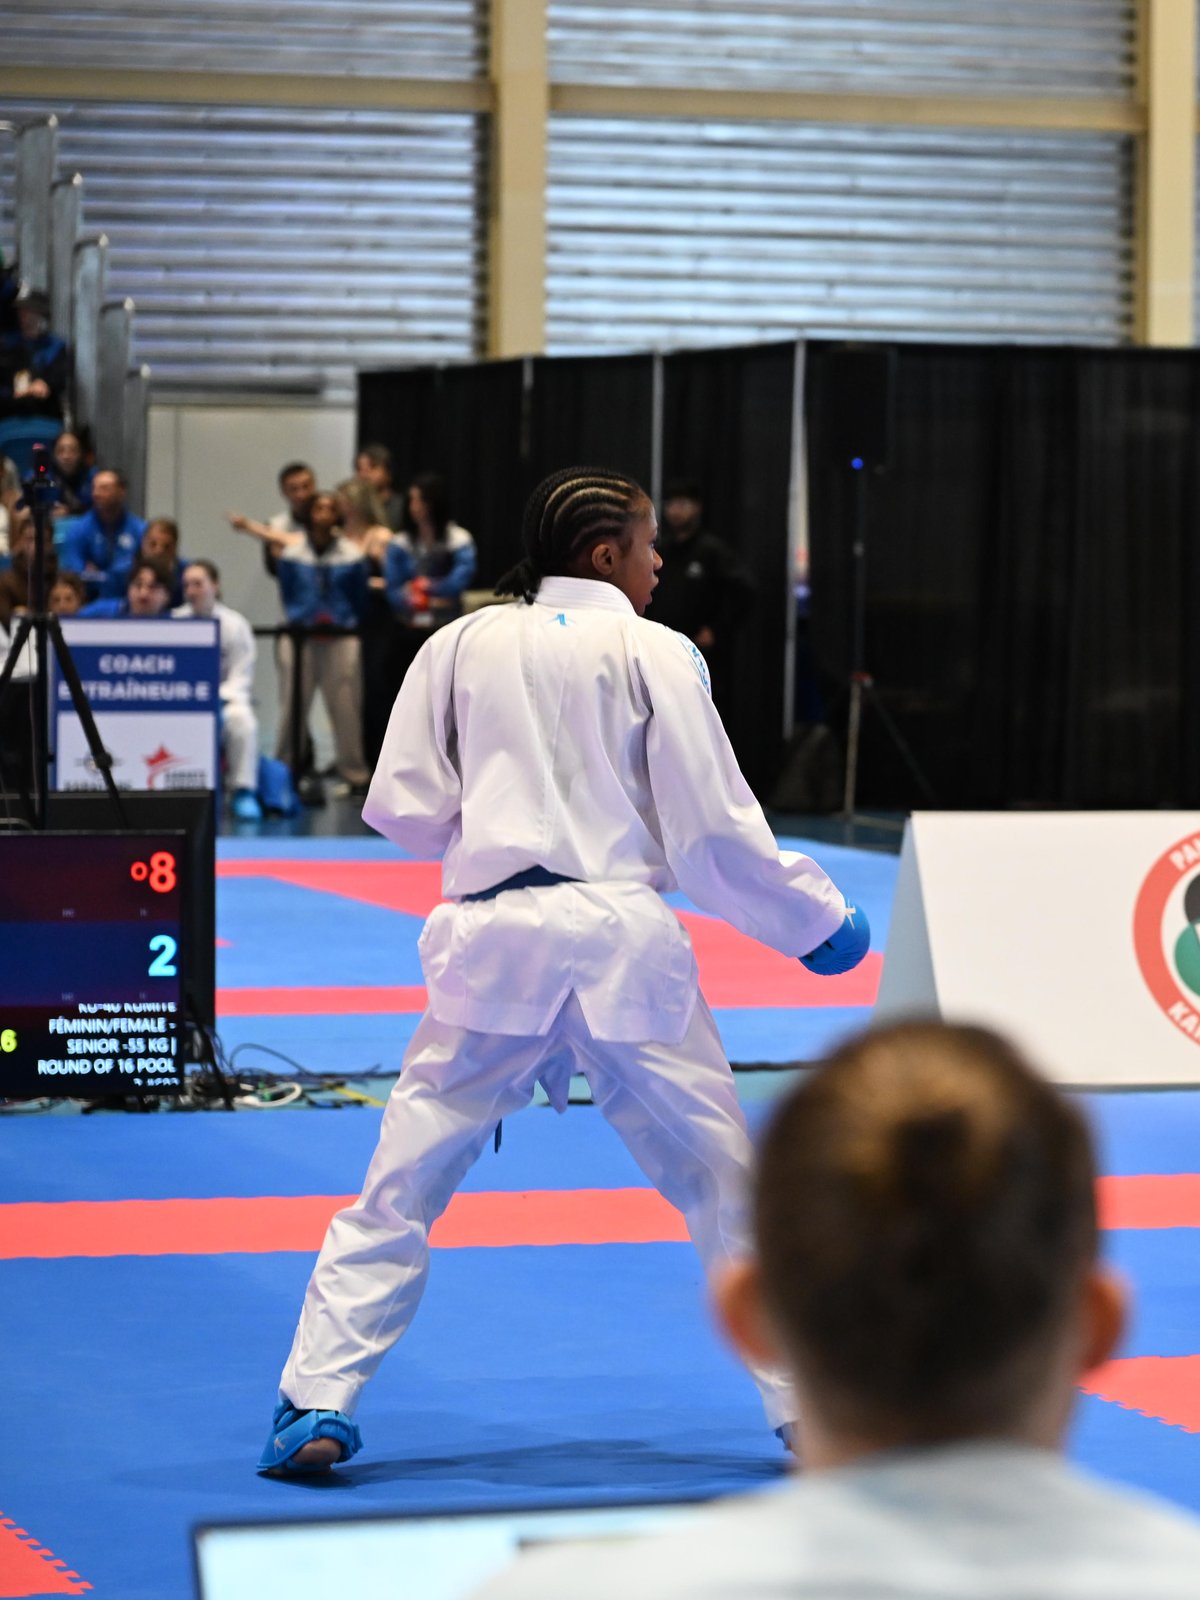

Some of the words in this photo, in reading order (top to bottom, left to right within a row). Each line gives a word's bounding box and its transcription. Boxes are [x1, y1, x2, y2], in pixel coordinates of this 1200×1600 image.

[99, 655, 175, 674] COACH
[149, 852, 176, 892] 8
[148, 935, 177, 976] 2
[49, 1017, 166, 1034] FÉMININ/FEMALE
[67, 1039, 119, 1054] SENIOR
[148, 1038, 169, 1053] KG
[38, 1060, 92, 1075] ROUND
[93, 1059, 114, 1074] OF
[118, 1059, 135, 1074] 16
[137, 1058, 176, 1073] POOL
